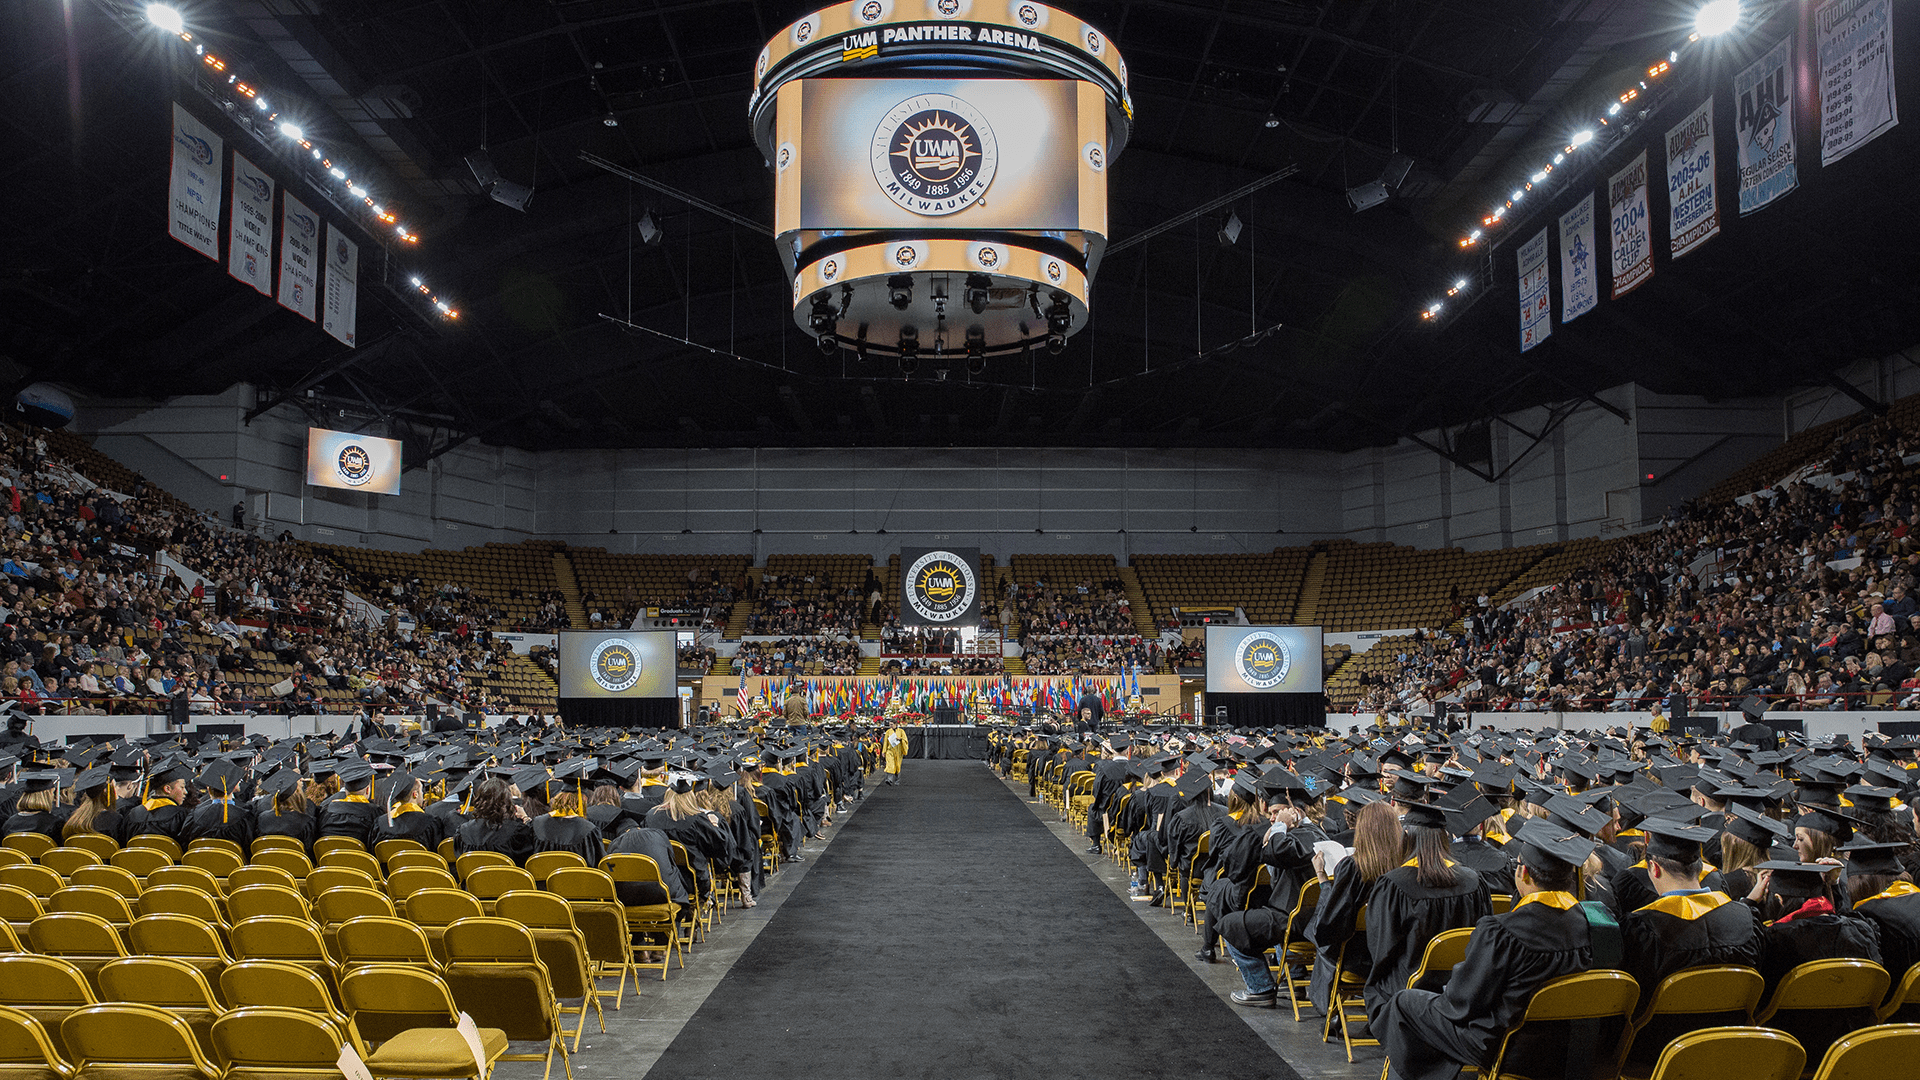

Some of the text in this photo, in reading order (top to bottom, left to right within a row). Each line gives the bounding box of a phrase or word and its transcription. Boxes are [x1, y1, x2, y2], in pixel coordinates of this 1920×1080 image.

[843, 25, 1041, 52] UWM PANTHER ARENA
[1832, 9, 1874, 45] DIVISION
[1739, 65, 1789, 133] AHL
[914, 139, 960, 157] UWM
[898, 167, 974, 195] 1849 1885 1956
[1670, 150, 1710, 193] 2005-06
[886, 180, 985, 211] MILWAUKEE
[1673, 183, 1712, 222] WESTERN
[175, 198, 217, 231] CHAMPIONS
[1613, 201, 1645, 236] 2004
[1670, 216, 1716, 251] CHAMPIONS
[1621, 249, 1640, 270] CUP
[907, 553, 938, 597] UNIVERSITY
[947, 554, 974, 598] WISCONSIN
[928, 577, 953, 588] UWM
[913, 601, 968, 619] MILWAUKEE
[607, 658, 626, 666] UWM
[1254, 652, 1274, 661] UWM
[596, 676, 637, 690] MILWAUKEE
[1242, 672, 1285, 686] MILWAUKEE
